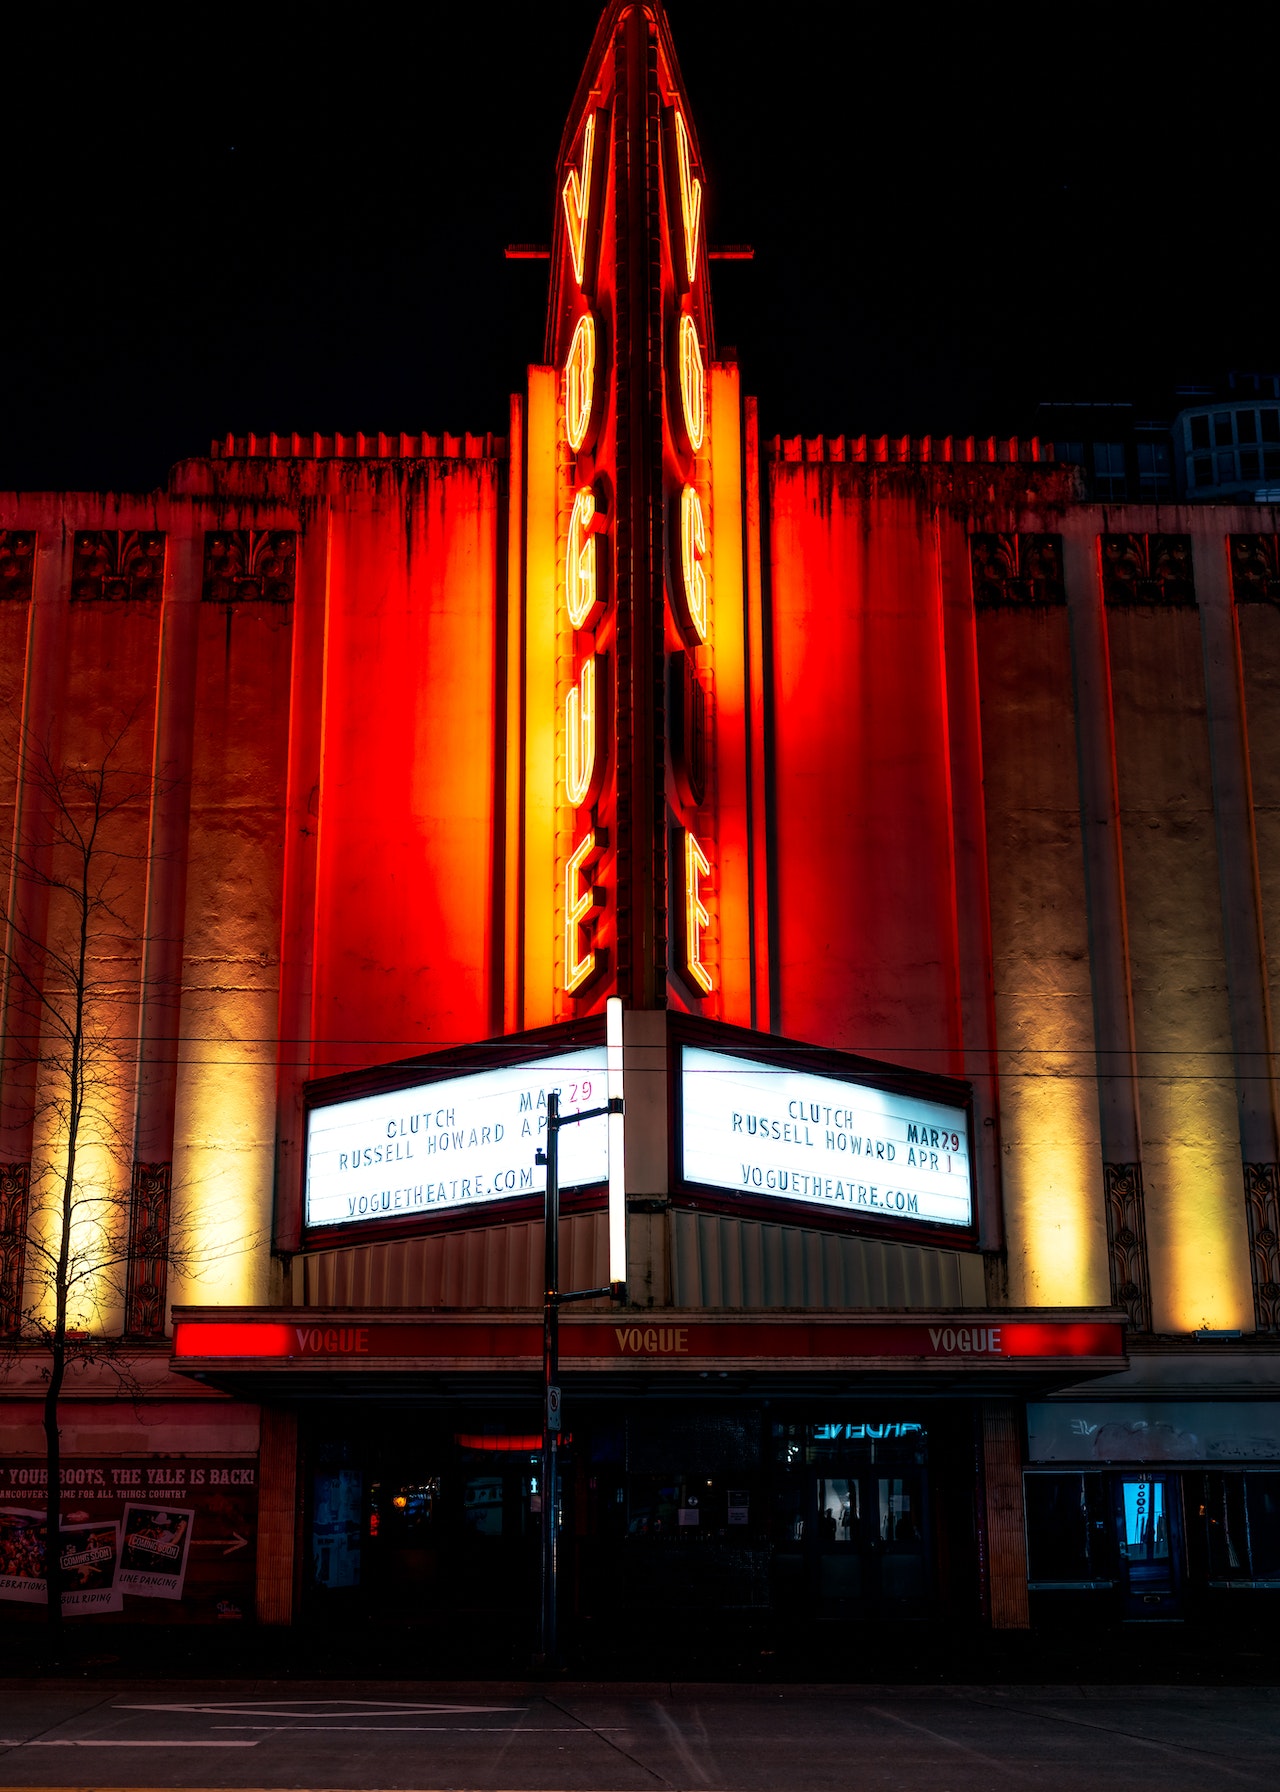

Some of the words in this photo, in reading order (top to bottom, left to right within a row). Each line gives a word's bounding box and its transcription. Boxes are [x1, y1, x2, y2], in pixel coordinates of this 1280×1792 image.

[561, 110, 604, 997] VOGUE
[672, 108, 713, 997] VOGUE
[387, 1108, 455, 1139] CLUTCH
[788, 1099, 853, 1129] CLUTCH
[338, 1141, 414, 1170] RUSSELL
[426, 1124, 504, 1155] HOWARD
[521, 1114, 561, 1138] AP
[732, 1112, 814, 1146] RUSSELL
[825, 1129, 896, 1162] HOWARD
[907, 1147, 939, 1172] APR
[947, 1154, 952, 1173] 1
[348, 1166, 534, 1215] VOGUETHEATRE.COM
[741, 1163, 919, 1213] VOGUETHEATRE.COM
[296, 1328, 369, 1353] VOGUE
[615, 1328, 689, 1353] VOGUE
[928, 1328, 1002, 1353] VOGUE
[9, 1469, 49, 1485] YOUR
[58, 1469, 106, 1486] BOOTS,
[111, 1469, 141, 1485] THE
[146, 1469, 186, 1485] YALE
[189, 1469, 206, 1485] IS
[209, 1469, 255, 1485] BACK!
[78, 1489, 95, 1499] FOR
[97, 1489, 114, 1499] ALL
[116, 1489, 147, 1499] THINGS
[148, 1489, 187, 1499] COUNTRY
[63, 1553, 91, 1567] COMING
[90, 1548, 110, 1561] SOON
[131, 1535, 158, 1551] COMING
[157, 1543, 178, 1557] SOON
[119, 1573, 139, 1583] LINE
[140, 1575, 178, 1590] DANCING
[60, 1594, 80, 1604] BULL
[82, 1593, 112, 1603] RIDING
